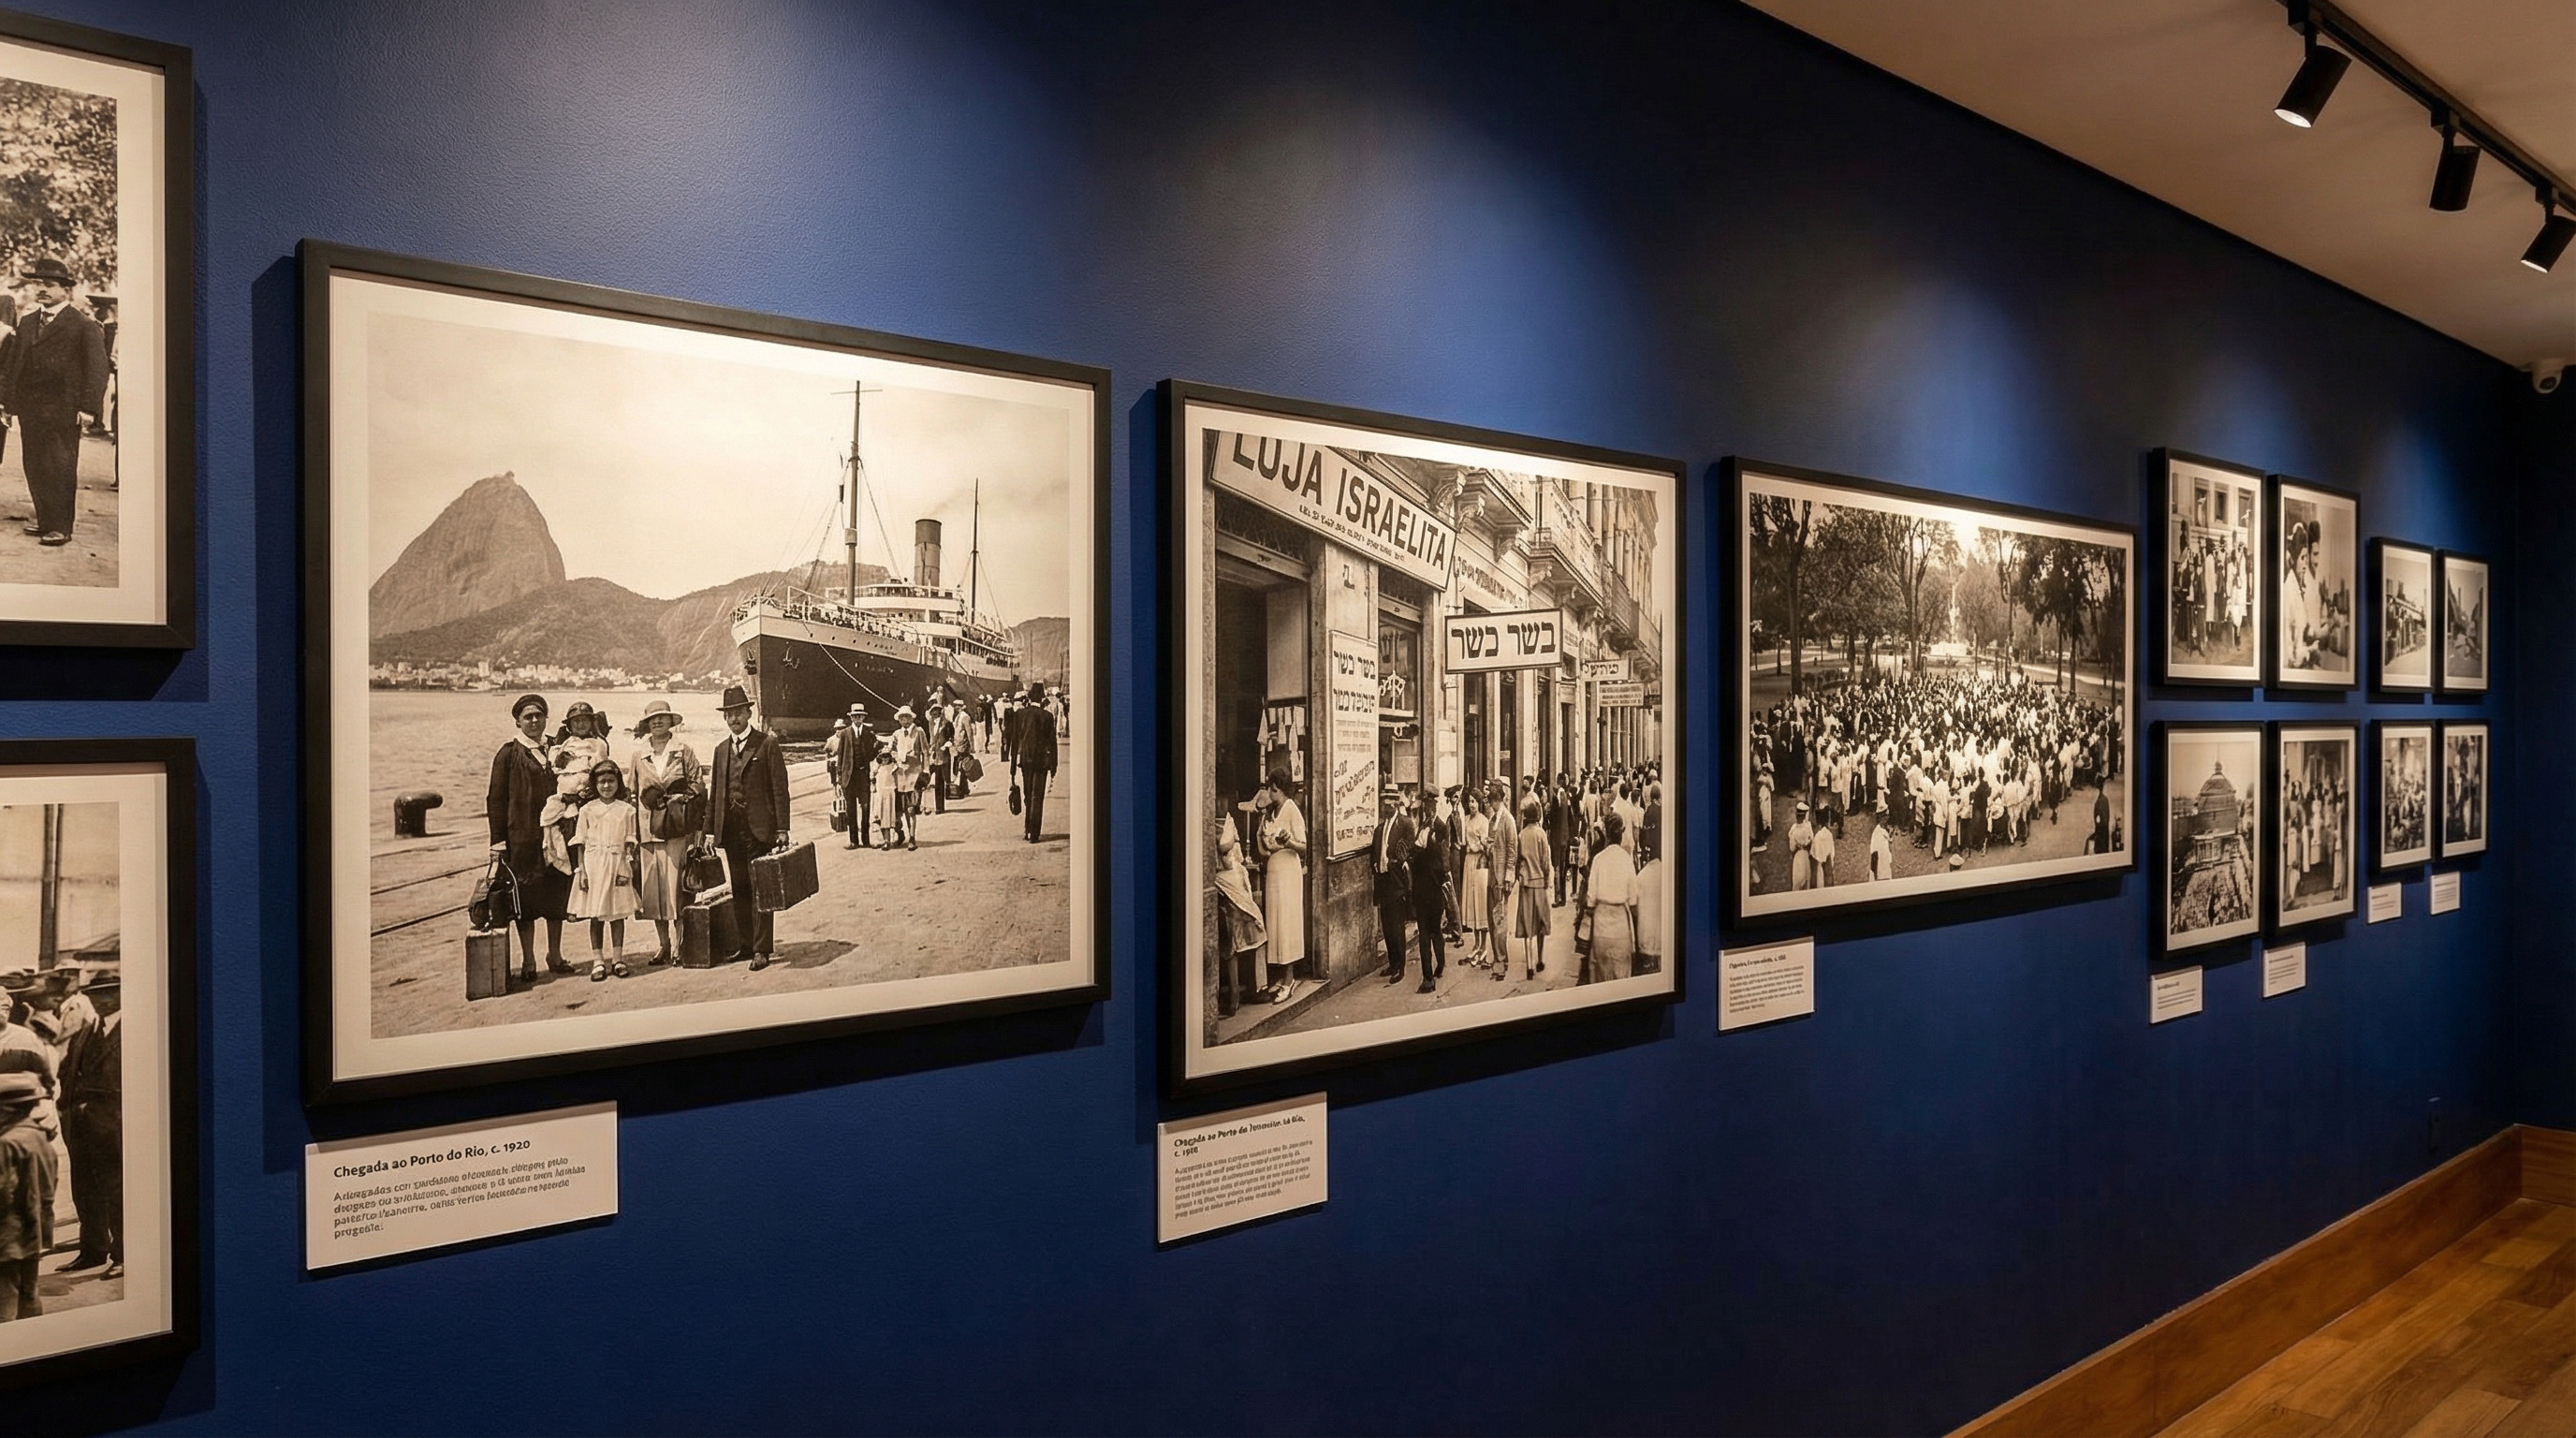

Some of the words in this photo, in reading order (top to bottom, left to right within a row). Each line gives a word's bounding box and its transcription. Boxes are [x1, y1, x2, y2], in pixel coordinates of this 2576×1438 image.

[1336, 468, 1447, 570] ISRAELITA
[1451, 625, 1500, 659] כשר
[1507, 622, 1556, 655] בשר
[334, 1160, 388, 1178] Chegada
[391, 1159, 407, 1169] ao
[410, 1153, 444, 1167] Porto
[446, 1149, 462, 1161] do
[465, 1145, 489, 1158] Rio,
[504, 1139, 531, 1153] 1920
